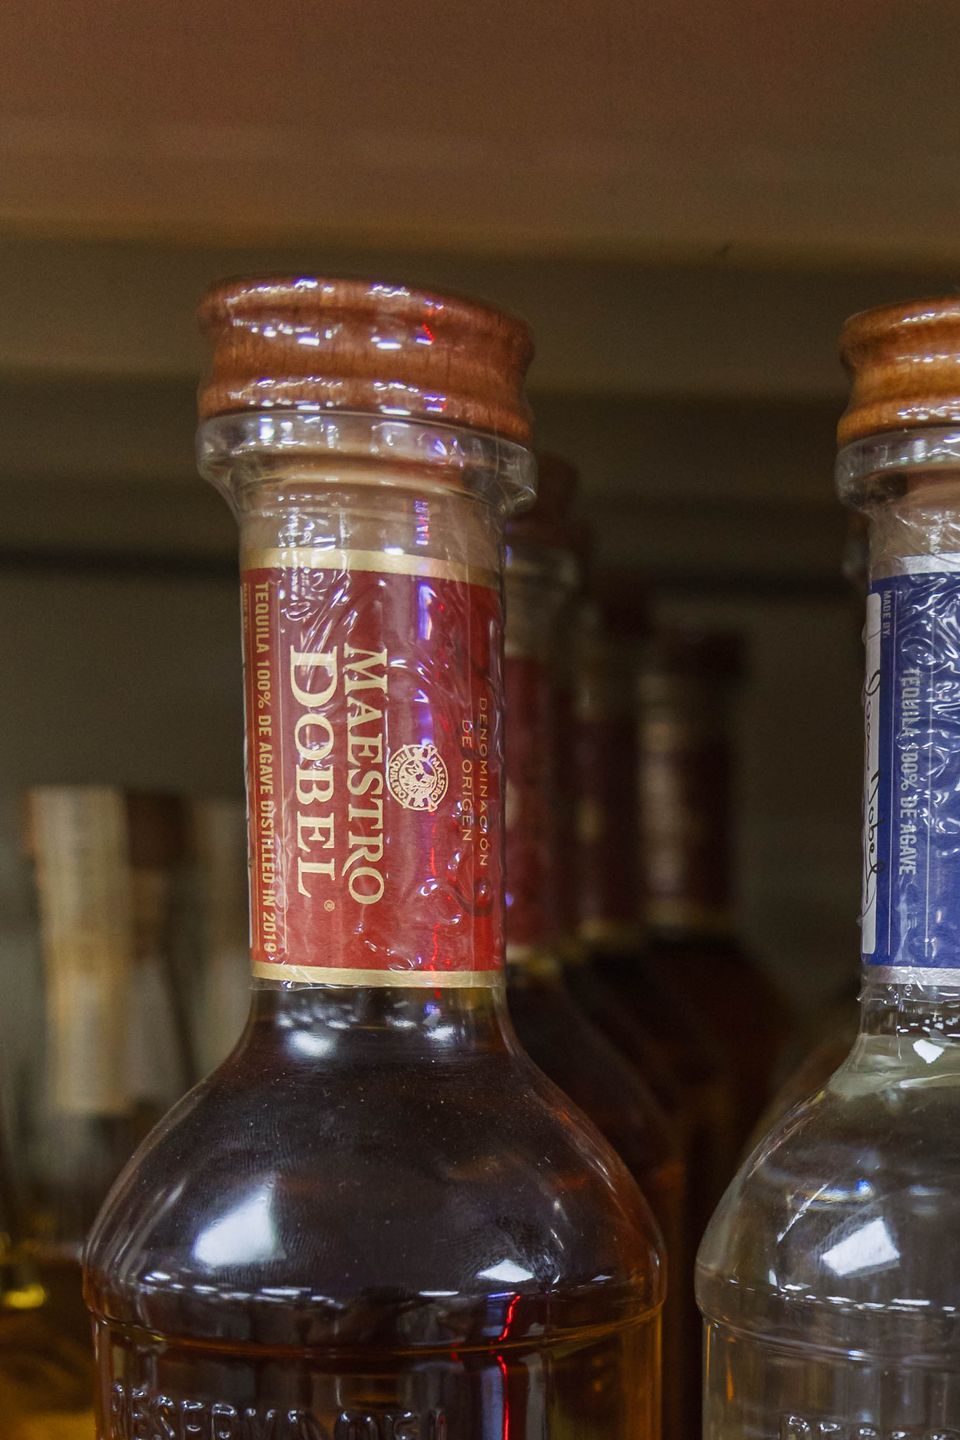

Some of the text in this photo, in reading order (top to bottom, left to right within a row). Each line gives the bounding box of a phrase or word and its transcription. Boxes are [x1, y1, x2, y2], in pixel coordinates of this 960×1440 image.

[255, 582, 271, 653] TEQUILA
[882, 590, 893, 618] MADE
[257, 660, 272, 709] 100%
[901, 666, 921, 738] TEQUILA
[259, 714, 273, 737] DE
[259, 746, 274, 795] AGAVE
[289, 644, 338, 898] DOBEL
[342, 642, 388, 905] MAESTRO
[461, 719, 474, 842] DE ORIGEN
[899, 796, 919, 819] DE
[260, 801, 276, 885] DISTILLED
[898, 820, 918, 876] AGAVE
[262, 889, 277, 907] IN
